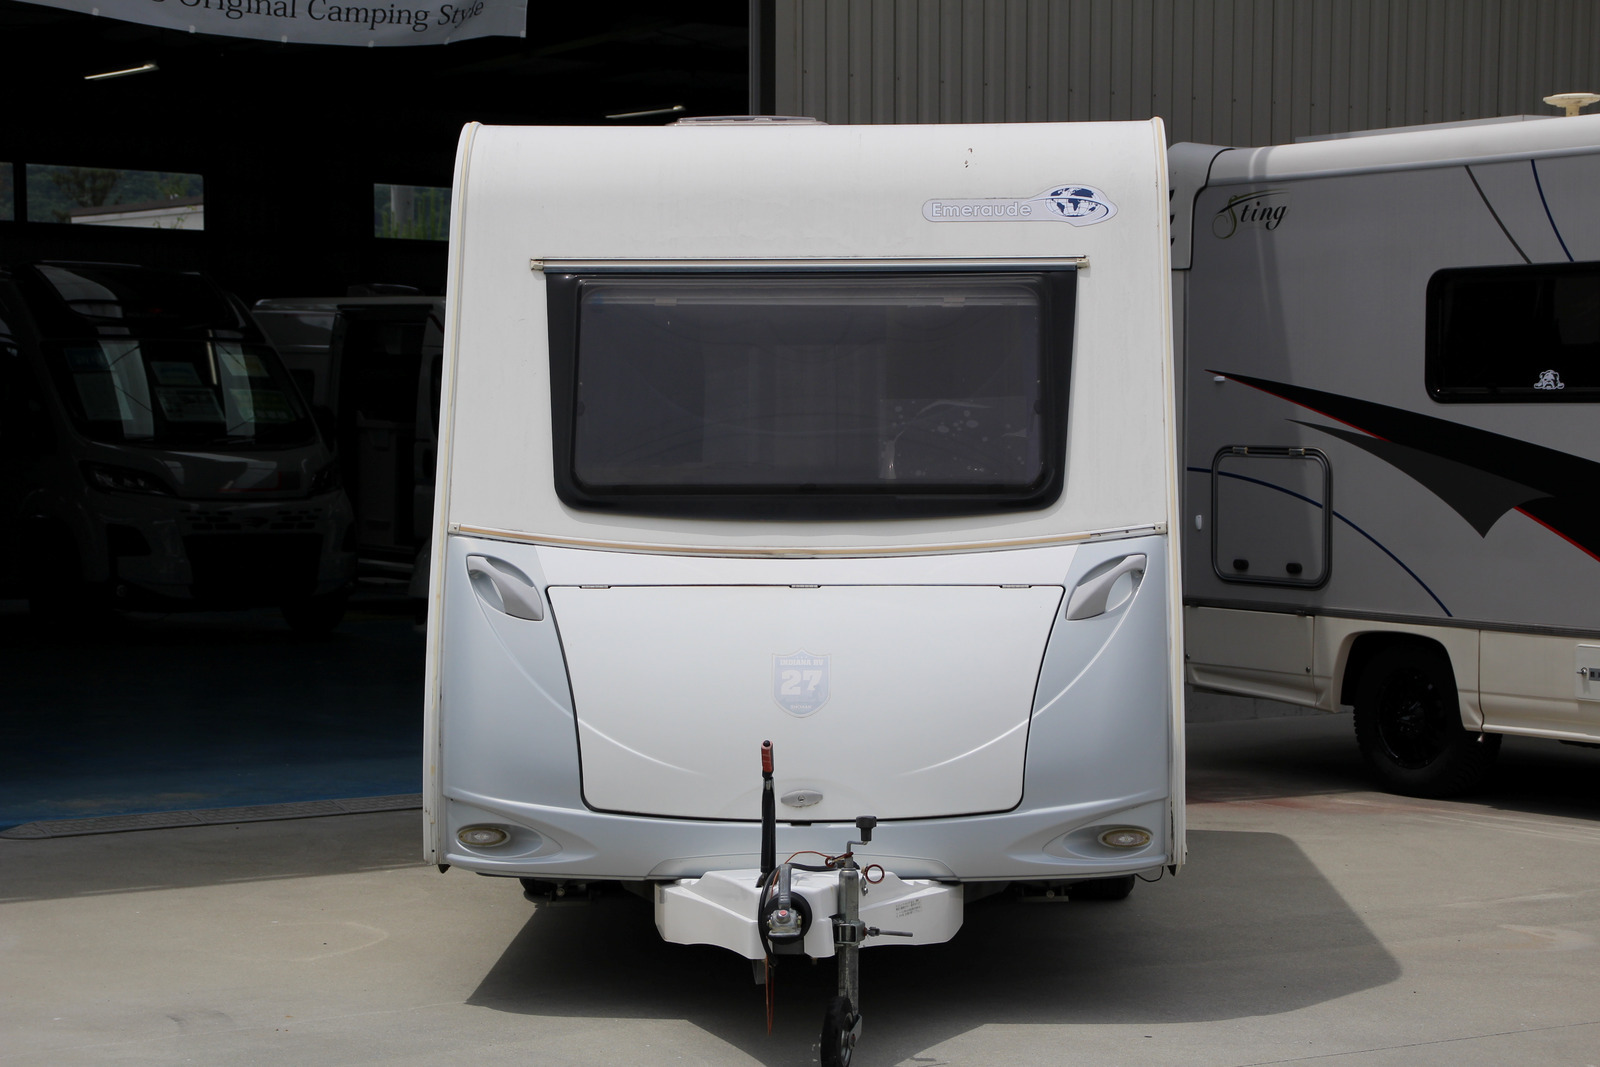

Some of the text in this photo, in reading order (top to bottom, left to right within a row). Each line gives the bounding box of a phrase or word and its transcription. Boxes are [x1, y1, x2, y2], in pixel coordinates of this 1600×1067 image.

[307, 0, 430, 33] Camping
[437, 1, 484, 29] Style
[931, 201, 1032, 217] Emeraude
[1212, 190, 1288, 239] Sting
[781, 669, 823, 696] 27
